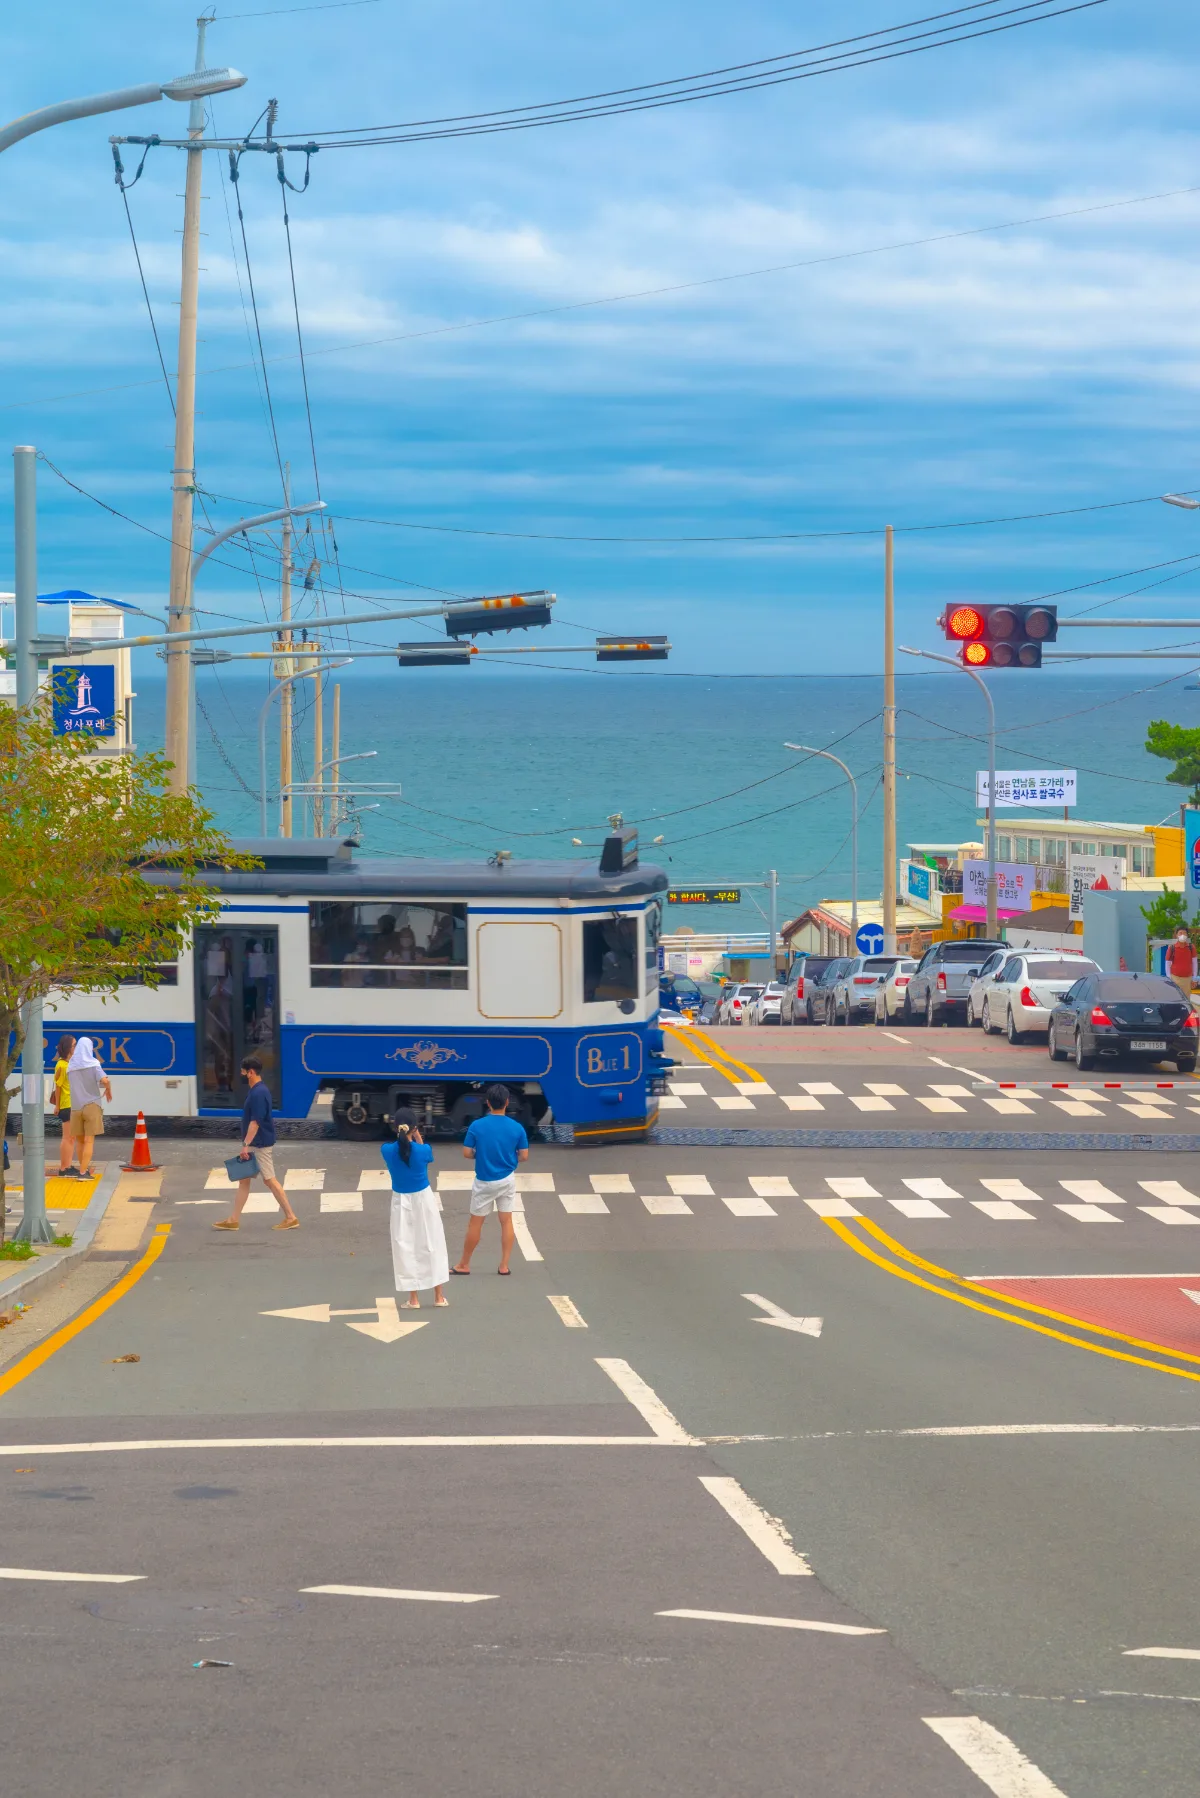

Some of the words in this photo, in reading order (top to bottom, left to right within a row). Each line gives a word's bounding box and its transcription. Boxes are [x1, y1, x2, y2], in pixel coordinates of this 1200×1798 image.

[63, 719, 105, 730] 청사포레
[1012, 777, 1036, 788] 연남동
[1039, 777, 1064, 788] 포가레
[1012, 788, 1037, 800] 청사포
[1039, 788, 1065, 800] 쌀국수
[620, 1045, 630, 1070] 1
